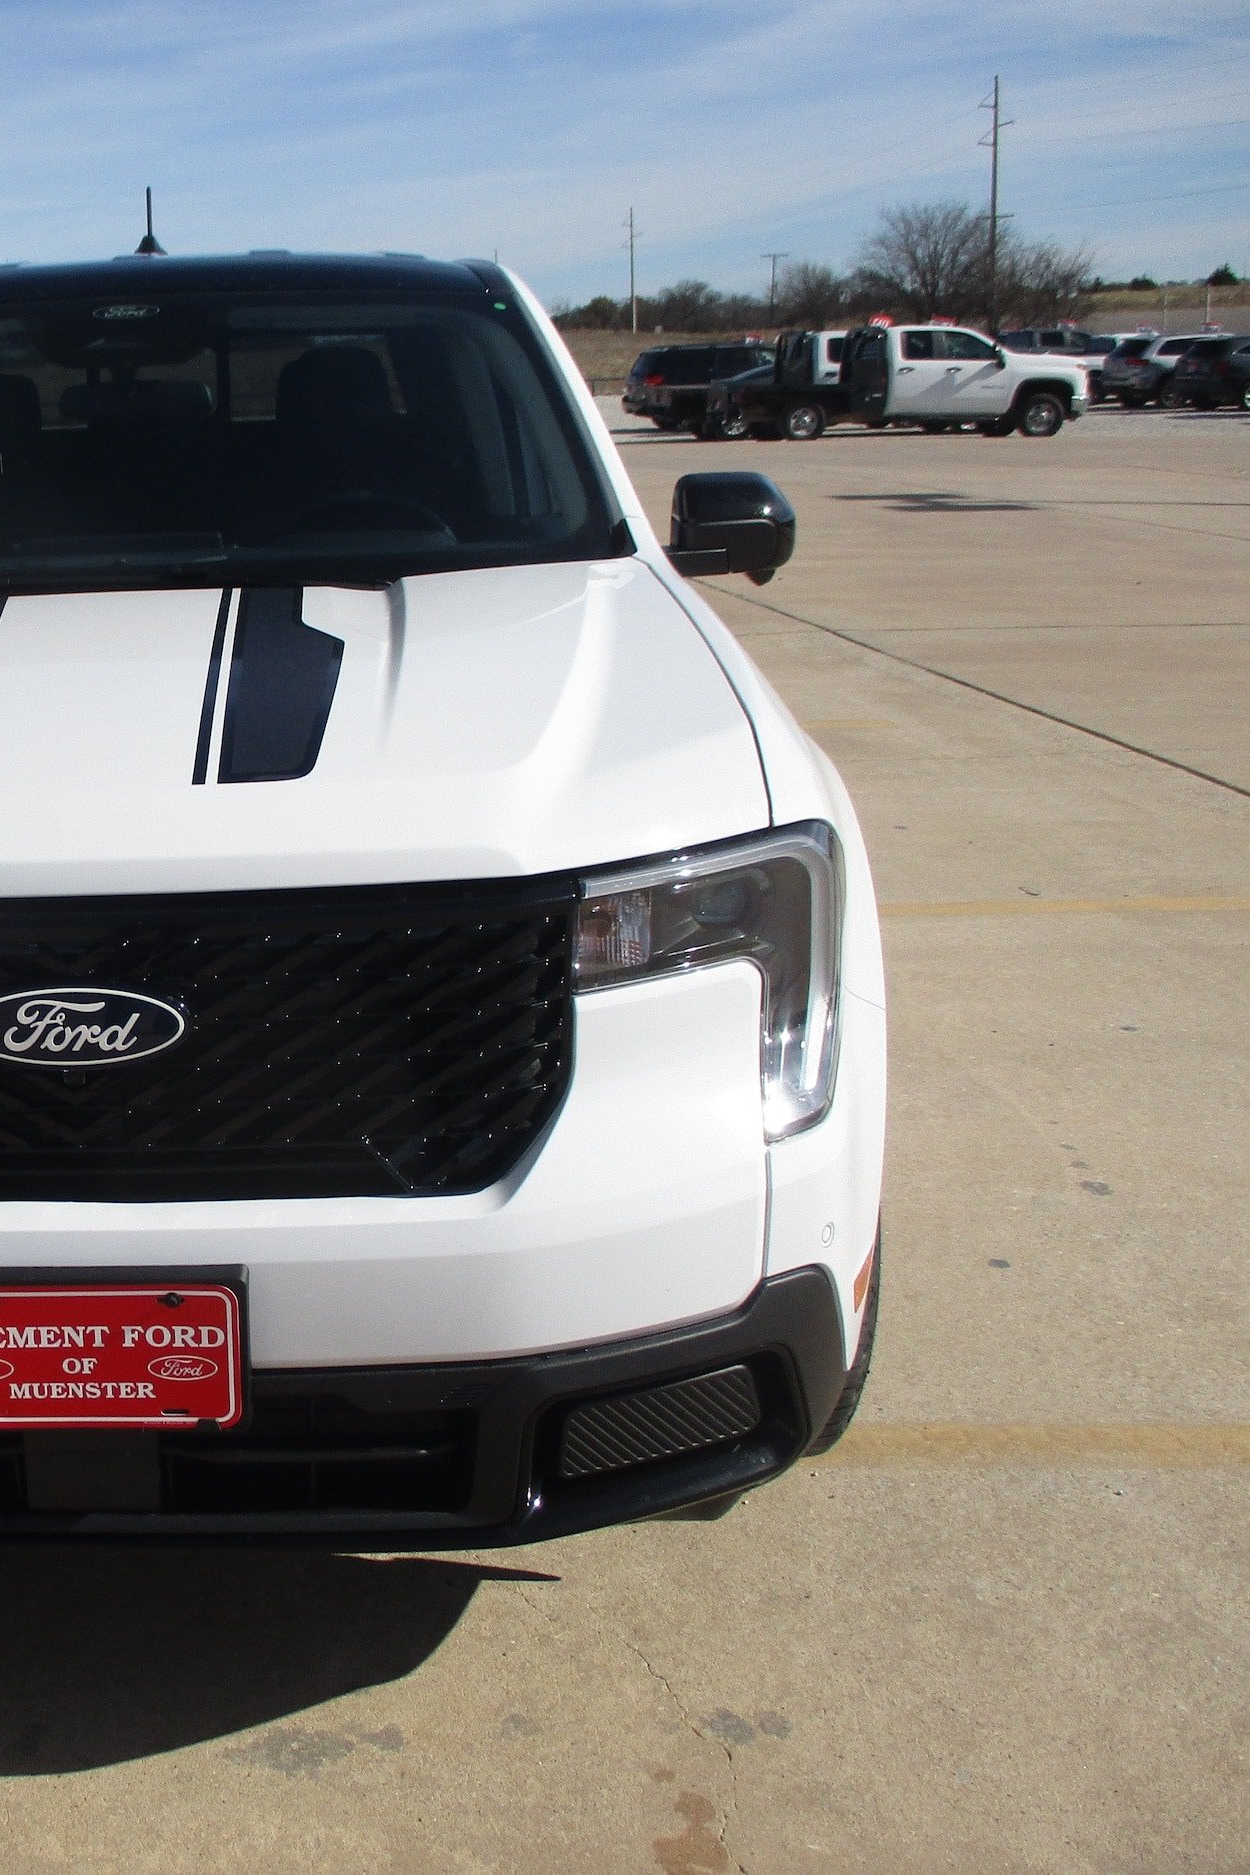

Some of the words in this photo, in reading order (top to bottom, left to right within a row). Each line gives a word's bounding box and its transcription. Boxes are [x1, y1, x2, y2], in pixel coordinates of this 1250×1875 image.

[3, 1000, 141, 1052] Ford
[121, 1325, 225, 1348] FORD
[62, 1357, 98, 1375] OF
[160, 1359, 203, 1377] Ford
[9, 1382, 157, 1400] MUENSTER
